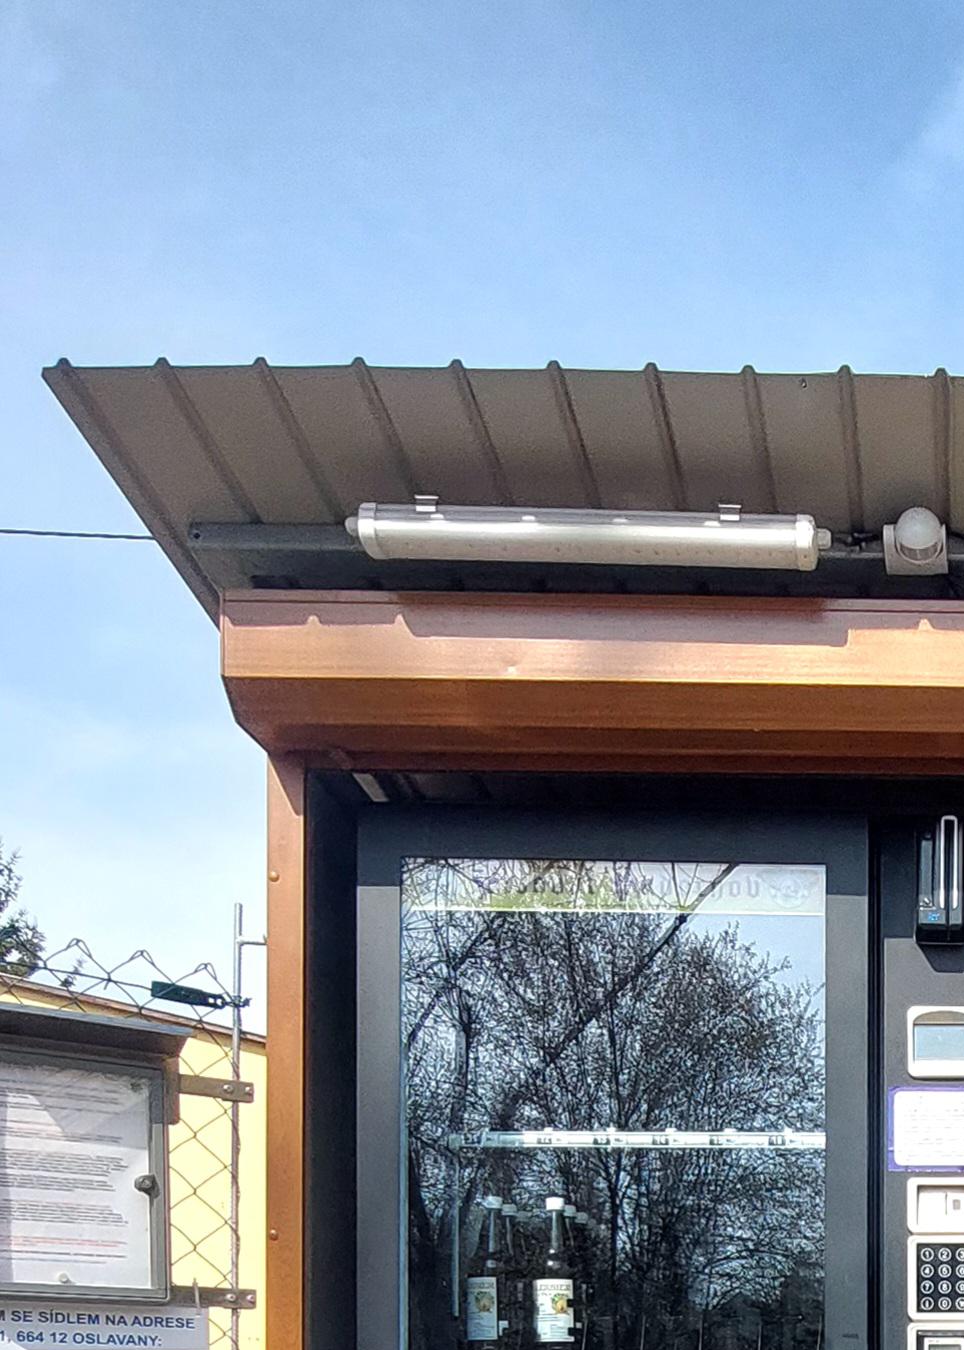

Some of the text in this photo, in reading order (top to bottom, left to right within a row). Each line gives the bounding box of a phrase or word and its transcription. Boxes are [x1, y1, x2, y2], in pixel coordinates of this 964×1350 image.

[11, 1310, 33, 1323] SE
[38, 1308, 100, 1325] SÍDLEM
[105, 1314, 128, 1327] NA
[130, 1316, 196, 1329] ADRESE
[16, 1330, 44, 1343] 664
[50, 1332, 68, 1344] 12
[72, 1332, 163, 1347] OSLAVANY:
